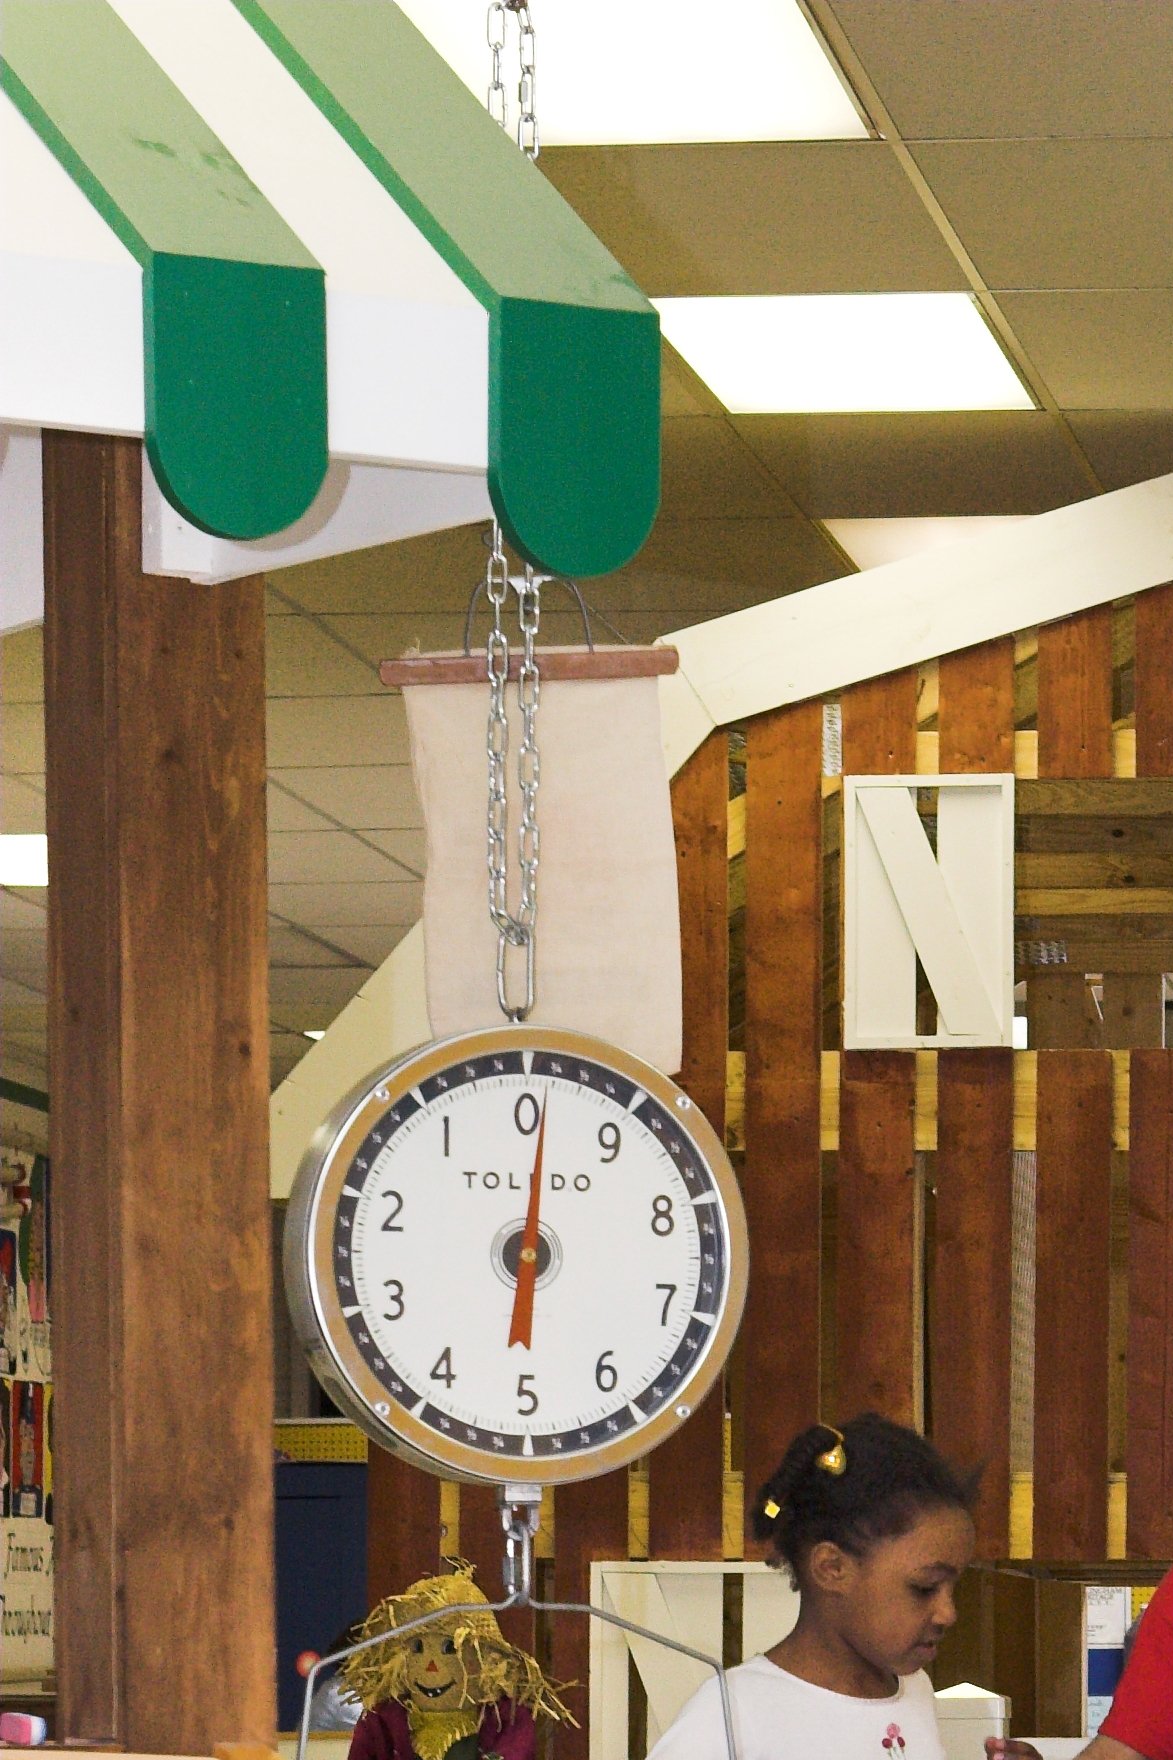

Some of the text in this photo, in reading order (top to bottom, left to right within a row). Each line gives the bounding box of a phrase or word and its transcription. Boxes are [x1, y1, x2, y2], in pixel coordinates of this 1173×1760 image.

[514, 1092, 540, 1136] 0
[442, 1115, 450, 1158] 1
[597, 1122, 622, 1164] 9
[462, 1171, 592, 1192] TOLDO
[380, 1190, 404, 1233] 2
[650, 1194, 675, 1237] 8
[383, 1279, 405, 1321] 3
[655, 1283, 677, 1327] 7
[429, 1346, 457, 1389] 4
[595, 1350, 618, 1393] 6
[517, 1374, 539, 1417] 5
